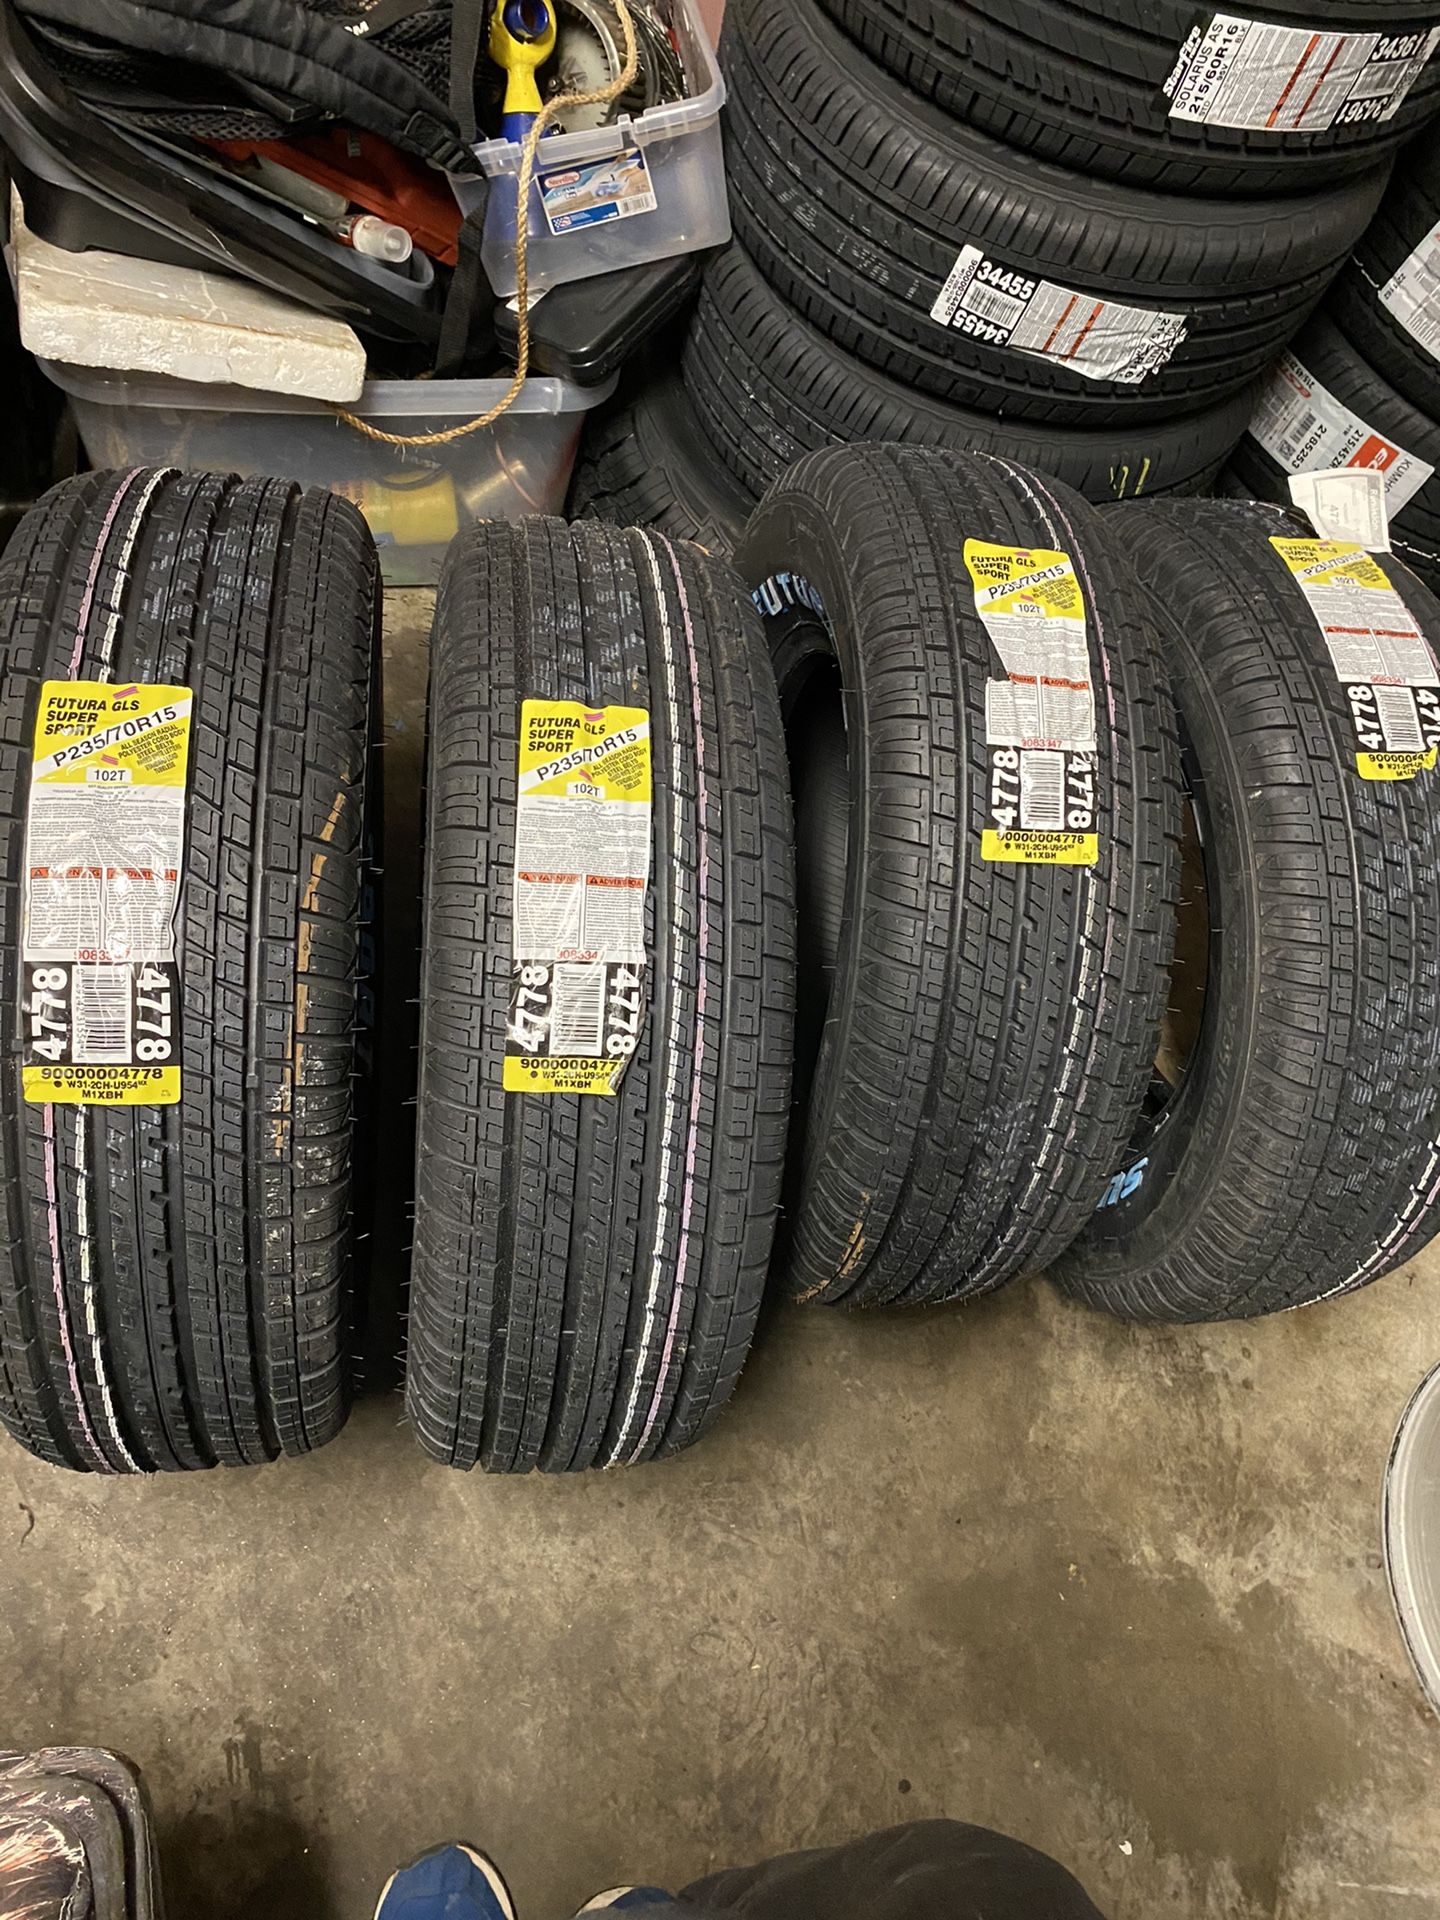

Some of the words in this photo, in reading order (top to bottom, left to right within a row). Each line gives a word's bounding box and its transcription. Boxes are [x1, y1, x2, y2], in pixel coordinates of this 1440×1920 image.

[1162, 25, 1201, 97] Starfire
[1372, 33, 1426, 61] 34361
[1175, 46, 1213, 110] SOLARUS
[1211, 22, 1225, 36] AS
[1188, 24, 1239, 114] 215/60R16
[976, 260, 1036, 300] 34455
[952, 309, 1009, 346] 34455
[1291, 424, 1327, 470] 2185253
[970, 556, 1013, 564] FUTURA
[1016, 558, 1036, 568] GLS
[973, 563, 1010, 572] SUPER
[976, 569, 1011, 581] SPORT
[988, 564, 1065, 600] P235/70R15
[1018, 604, 1041, 614] 102T
[46, 711, 99, 723] SUPER
[47, 697, 107, 711] FUTURA
[112, 700, 140, 712] GLS
[1347, 685, 1383, 750] 4778
[44, 723, 96, 736] SPORT
[52, 706, 177, 767] P235/70R15
[120, 740, 133, 751] ALL
[132, 730, 157, 747] SEASON
[157, 724, 178, 737] RADIAL
[528, 729, 575, 740] SUPER
[529, 717, 581, 729] FUTURA
[583, 722, 606, 736] GLS
[118, 741, 152, 759] POLYESTER
[151, 733, 170, 746] CORD
[169, 728, 186, 739] BODY
[136, 747, 155, 759] STEEL
[155, 740, 174, 751] BELTS
[528, 742, 573, 753] SPORT
[536, 728, 637, 781] P235/70R15
[94, 769, 126, 782] 102T
[574, 783, 600, 797] 102T
[991, 750, 1019, 826] 4778
[1067, 754, 1094, 829] 4778
[31, 967, 68, 1061] 4778
[136, 967, 172, 1062] 4778
[514, 965, 549, 1052] 4778
[606, 968, 640, 1055] 4778
[41, 1067, 163, 1080] 90000004778
[82, 1090, 124, 1099] M1XBH
